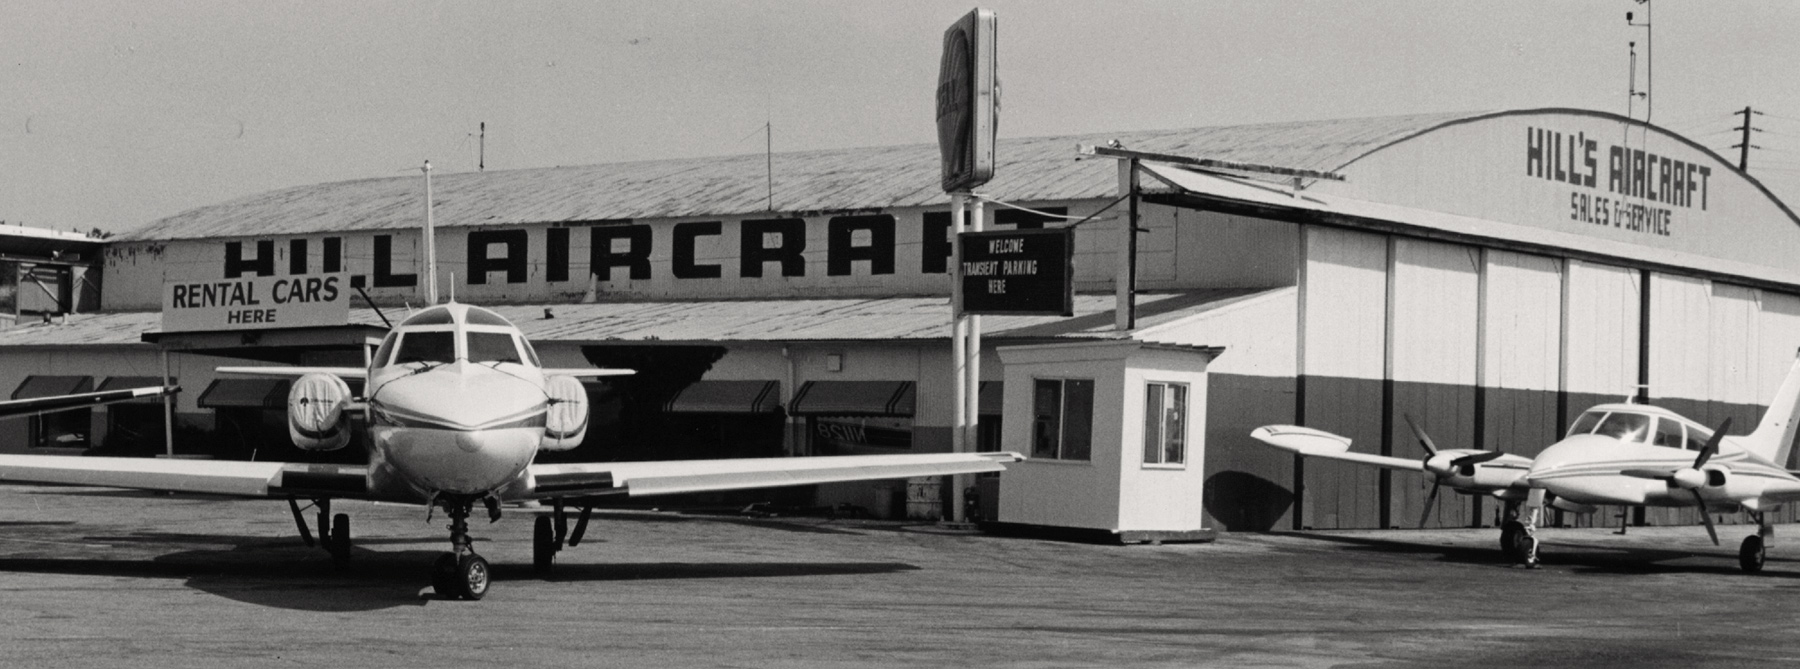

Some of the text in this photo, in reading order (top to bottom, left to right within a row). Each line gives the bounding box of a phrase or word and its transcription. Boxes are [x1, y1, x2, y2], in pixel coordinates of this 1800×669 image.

[1527, 126, 1711, 211] HILL'S AIRCRAFT
[1571, 192, 1609, 226] SALES
[1626, 203, 1671, 236] SERVICE
[989, 239, 1024, 254] WELCOME
[224, 235, 417, 287] HILL
[963, 260, 1037, 276] TRANSIENT PARKING
[173, 277, 338, 308] RENTAL CARS
[988, 279, 1006, 294] HERE
[228, 309, 277, 324] HERE
